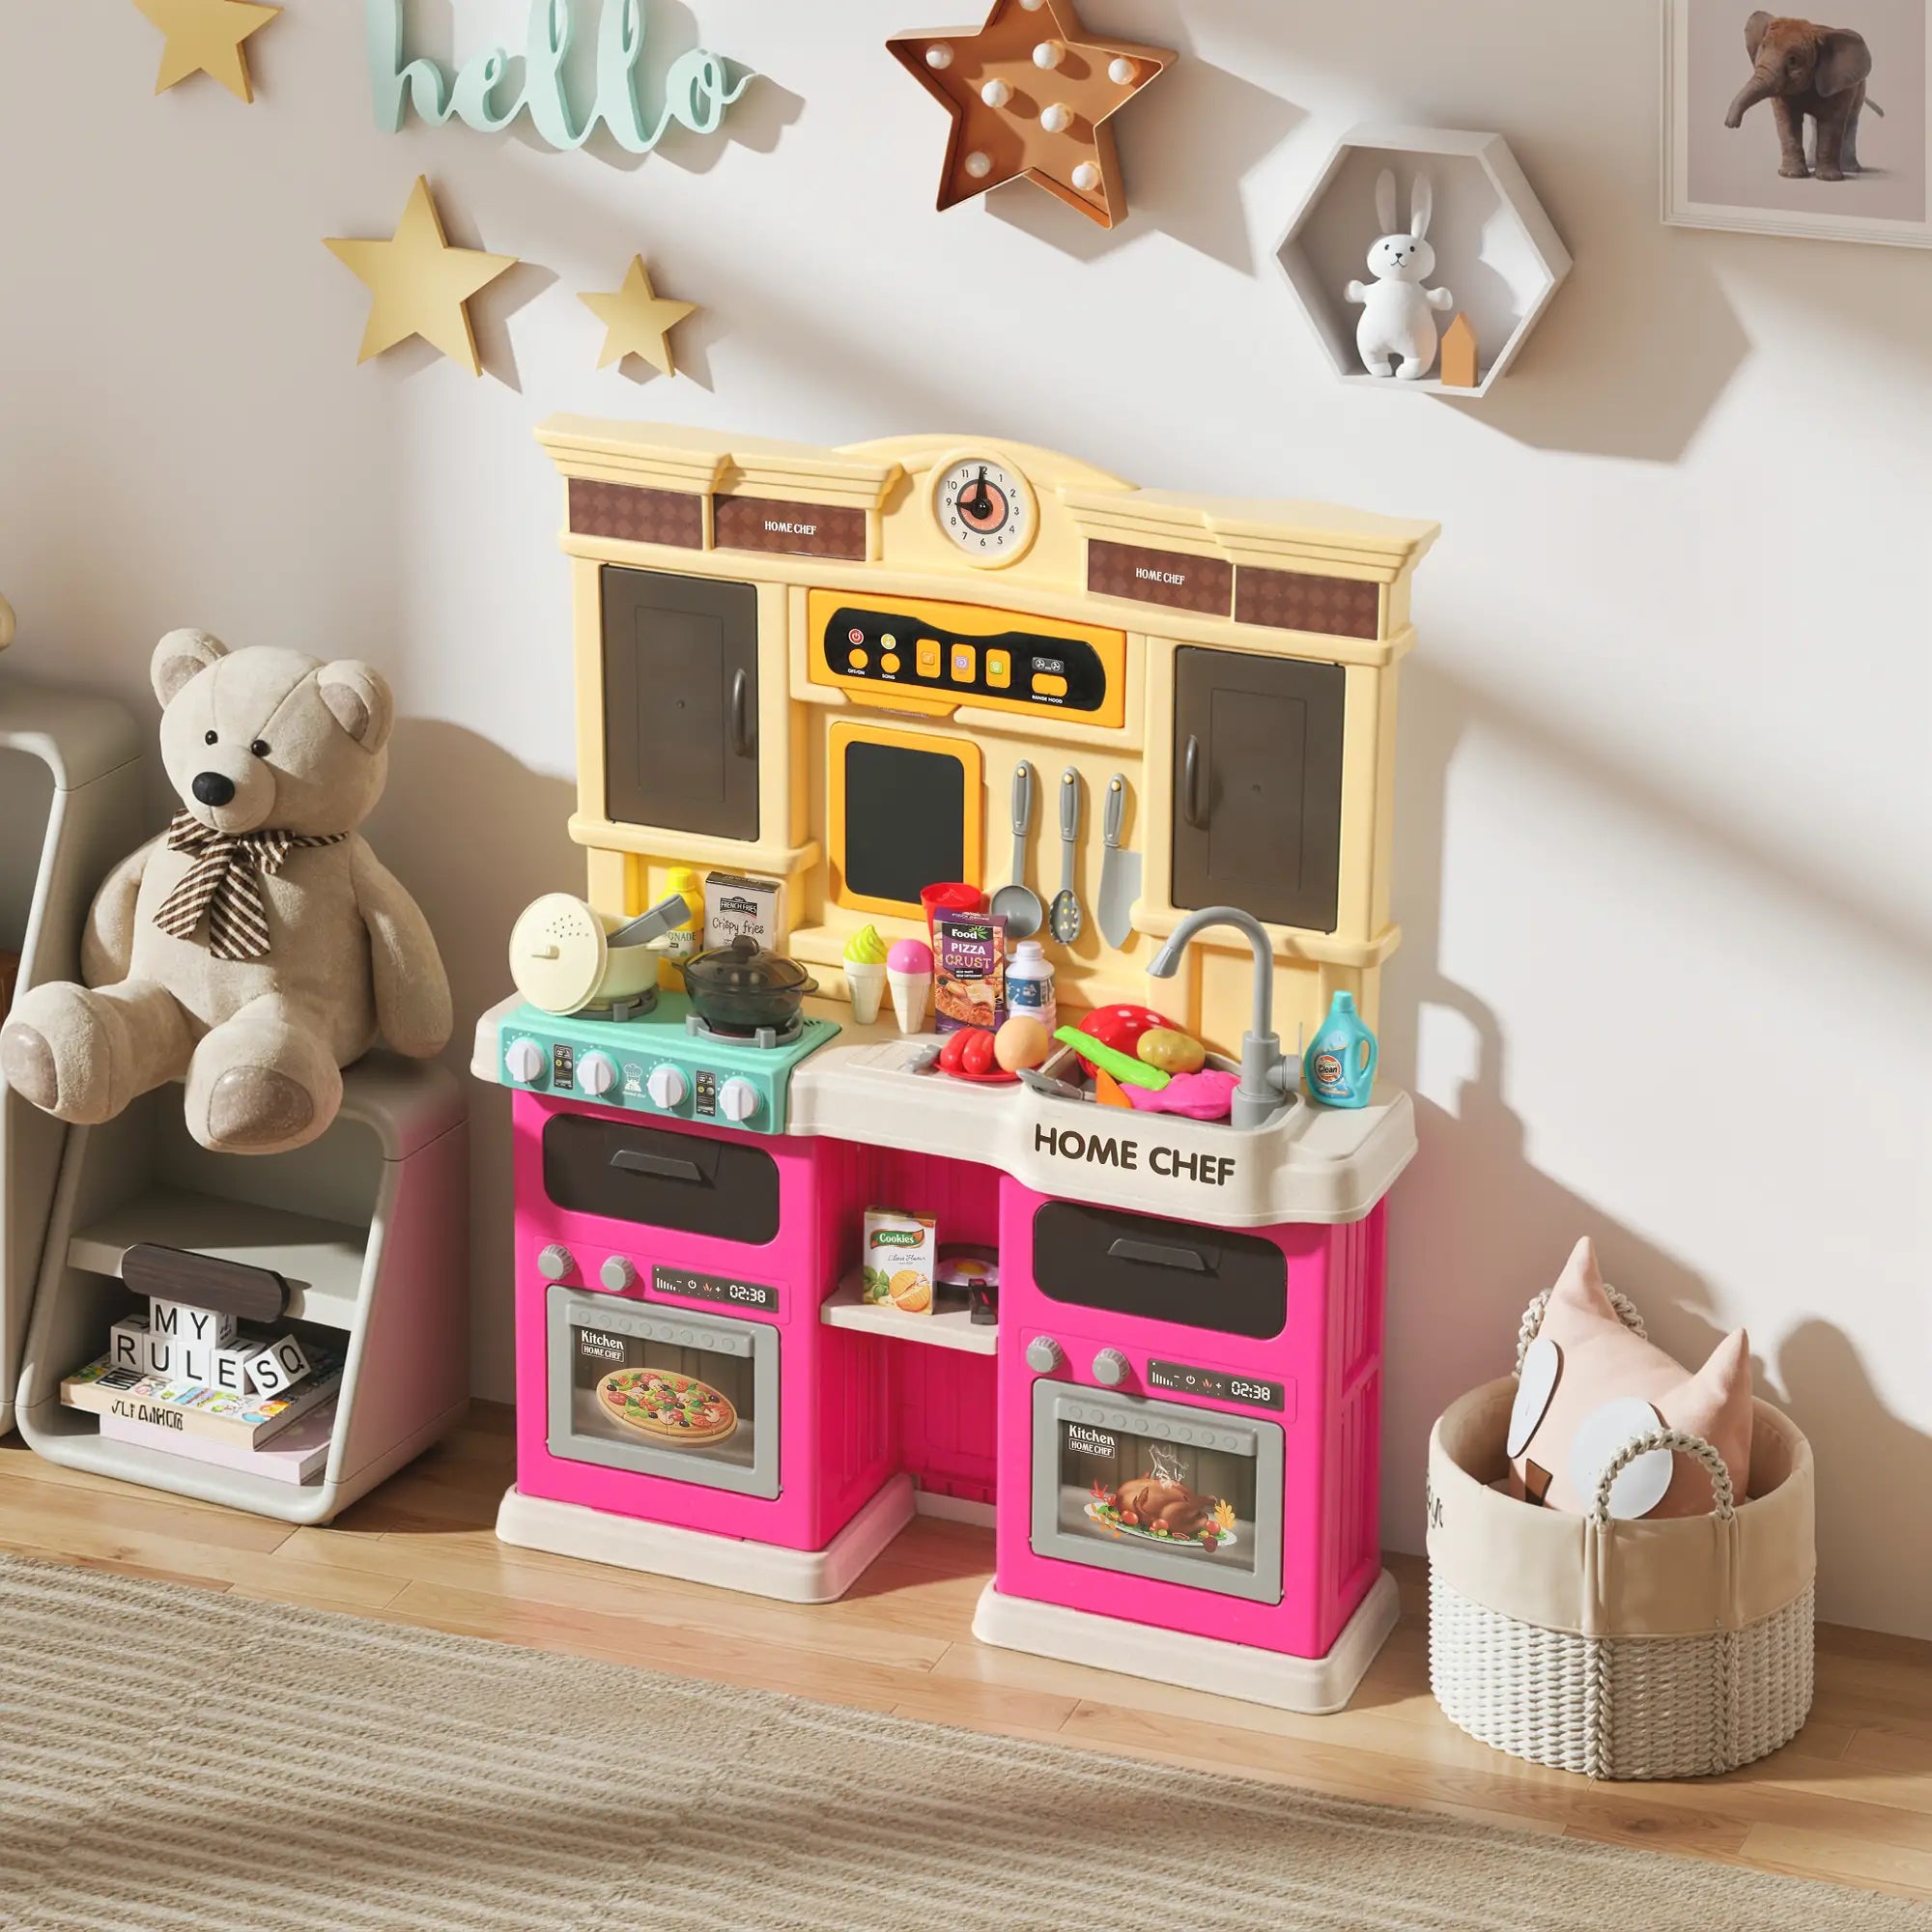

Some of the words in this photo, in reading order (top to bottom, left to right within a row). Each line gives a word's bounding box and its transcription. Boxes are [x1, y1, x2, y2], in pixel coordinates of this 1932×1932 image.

[365, 0, 760, 154] hello
[961, 469, 969, 478] 11
[999, 473, 1004, 483] 1
[947, 480, 957, 490] 10
[1009, 488, 1016, 498] 2
[946, 497, 952, 506] 9
[1013, 506, 1020, 516] 3
[764, 520, 793, 533] HOME
[793, 523, 817, 535] CHEF
[951, 517, 957, 526] 8
[1009, 525, 1015, 534] 4
[962, 531, 968, 541] 7
[997, 536, 1004, 546] 5
[980, 538, 986, 547] 6
[1135, 567, 1162, 582] HOME
[1162, 572, 1185, 585] CHEF
[712, 917, 739, 937] Crispy
[743, 920, 764, 935] fries
[952, 928, 978, 940] Food
[951, 942, 985, 955] PIZZA
[945, 953, 992, 970] CRUST
[1318, 1064, 1338, 1074] Clean
[1035, 1123, 1138, 1170] HOME
[1149, 1147, 1236, 1186] CHEF
[879, 1233, 915, 1244] Cookies
[729, 1284, 767, 1304] 02:38
[155, 1303, 210, 1341] MY
[581, 1329, 624, 1350] Kitchen
[583, 1345, 605, 1357] HOME
[604, 1350, 622, 1360] CHEF
[1231, 1379, 1271, 1402] 02:38
[1068, 1424, 1115, 1446] Kitchen
[1071, 1440, 1094, 1453] HOME
[1094, 1445, 1112, 1457] CHEF
